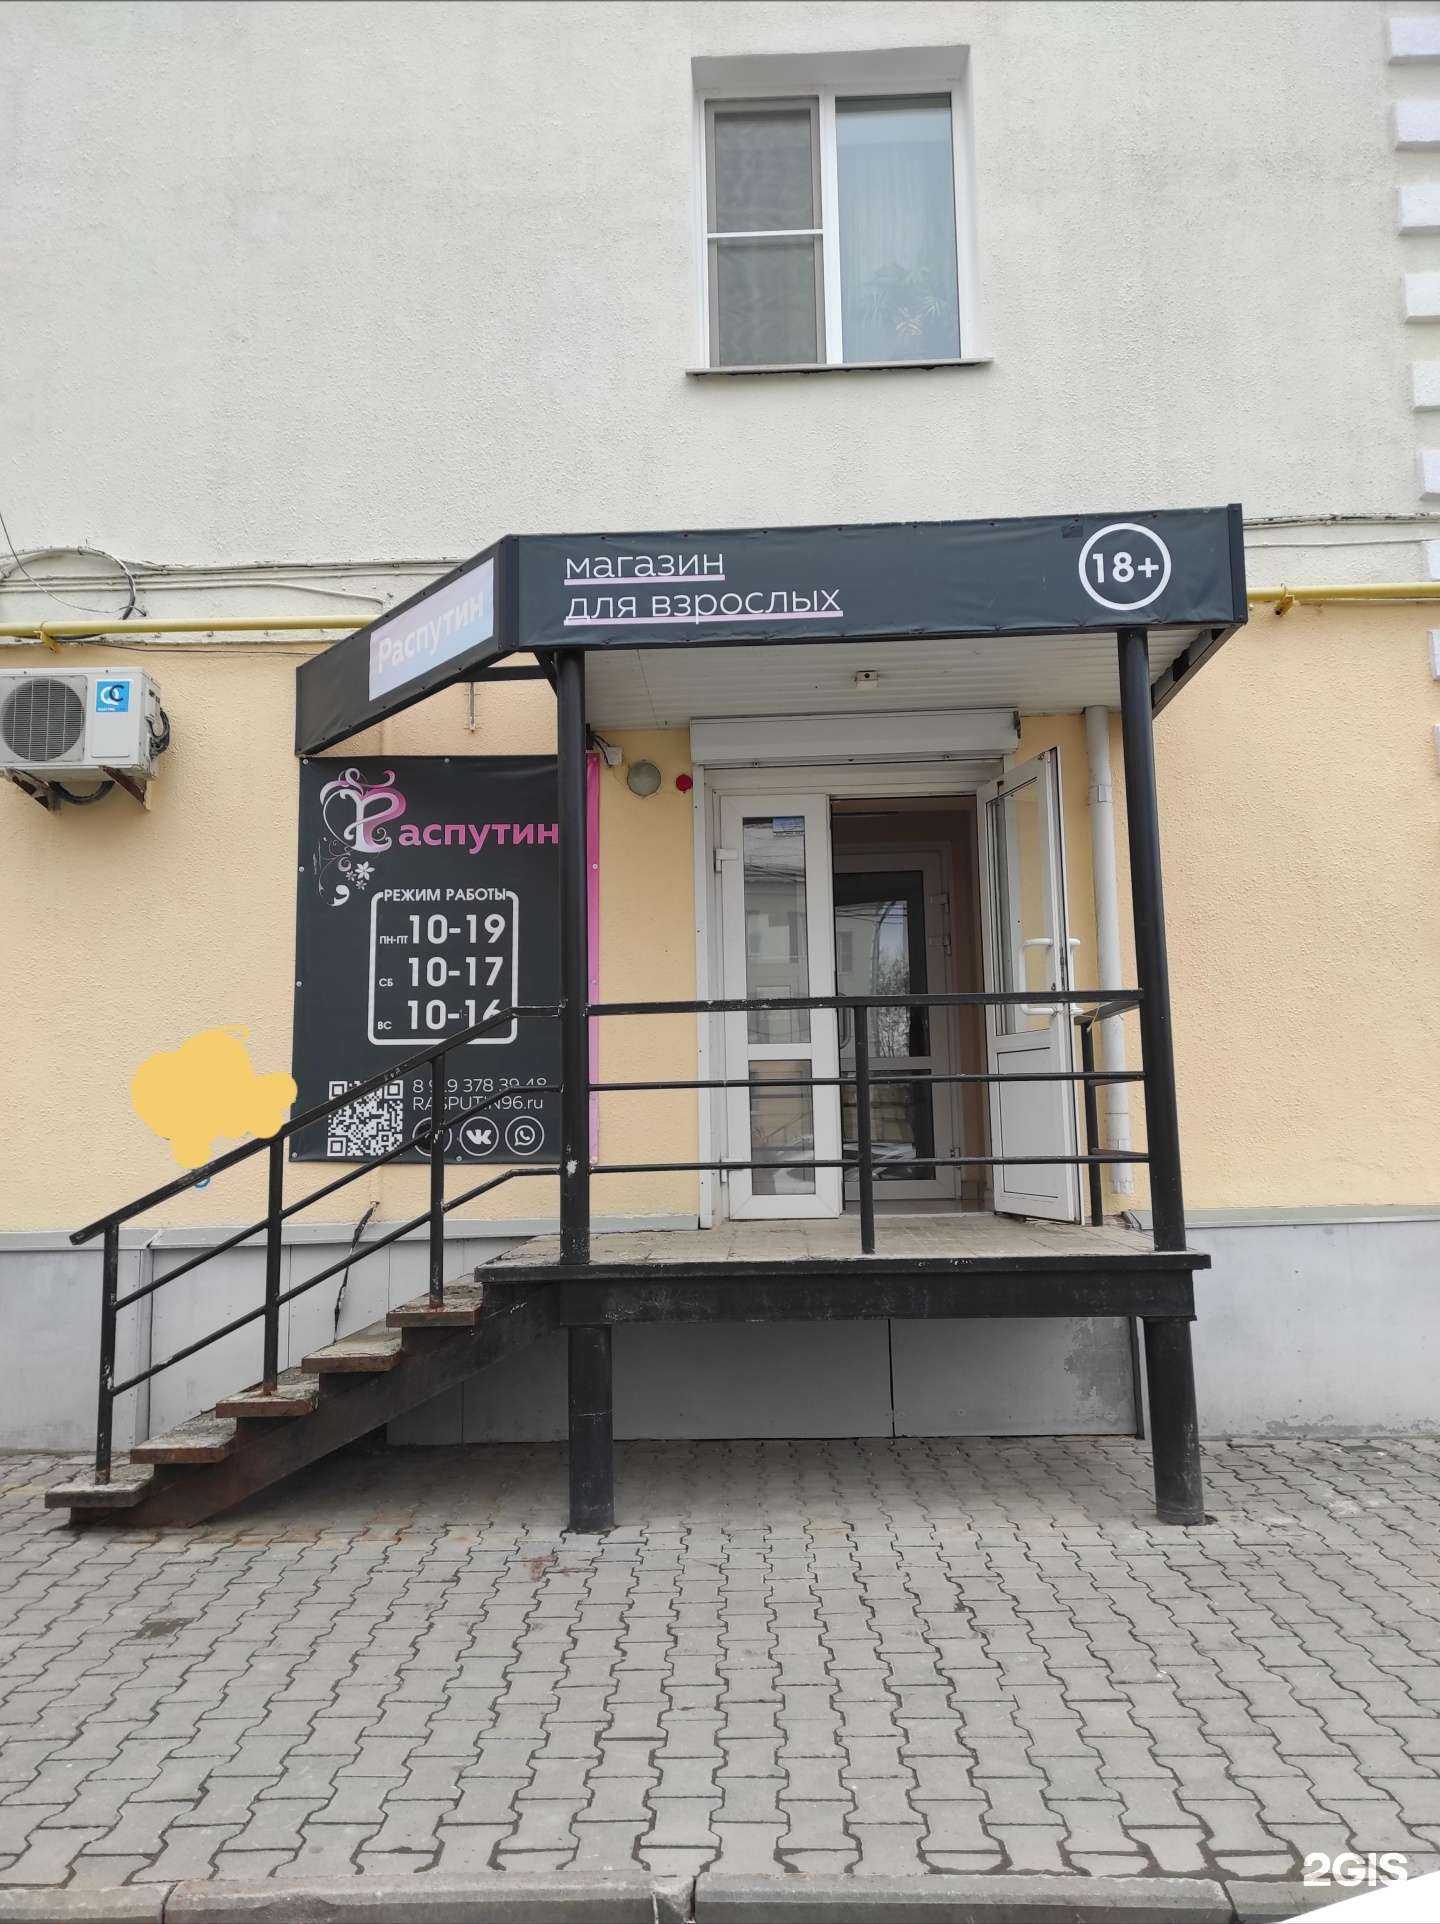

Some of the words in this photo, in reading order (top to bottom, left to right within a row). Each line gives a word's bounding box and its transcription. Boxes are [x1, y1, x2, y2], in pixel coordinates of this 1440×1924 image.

[565, 553, 724, 579] магазин
[1092, 551, 1160, 583] 18+
[566, 596, 637, 624] для
[651, 589, 841, 625] взрослых
[377, 592, 485, 675] Распутин
[319, 767, 560, 855] Распутин
[383, 888, 441, 902] РЕЖИМ
[446, 887, 507, 901] РАБОТЫ
[379, 935, 409, 945] ПН-ПТ
[409, 913, 506, 945] 10-19
[378, 978, 394, 987] СБ
[408, 956, 504, 987] 10-17
[377, 1020, 393, 1030] ВС
[412, 1079, 424, 1093] 8
[463, 1079, 494, 1093] 378
[412, 1096, 544, 1111] RAPUTN96.ru
